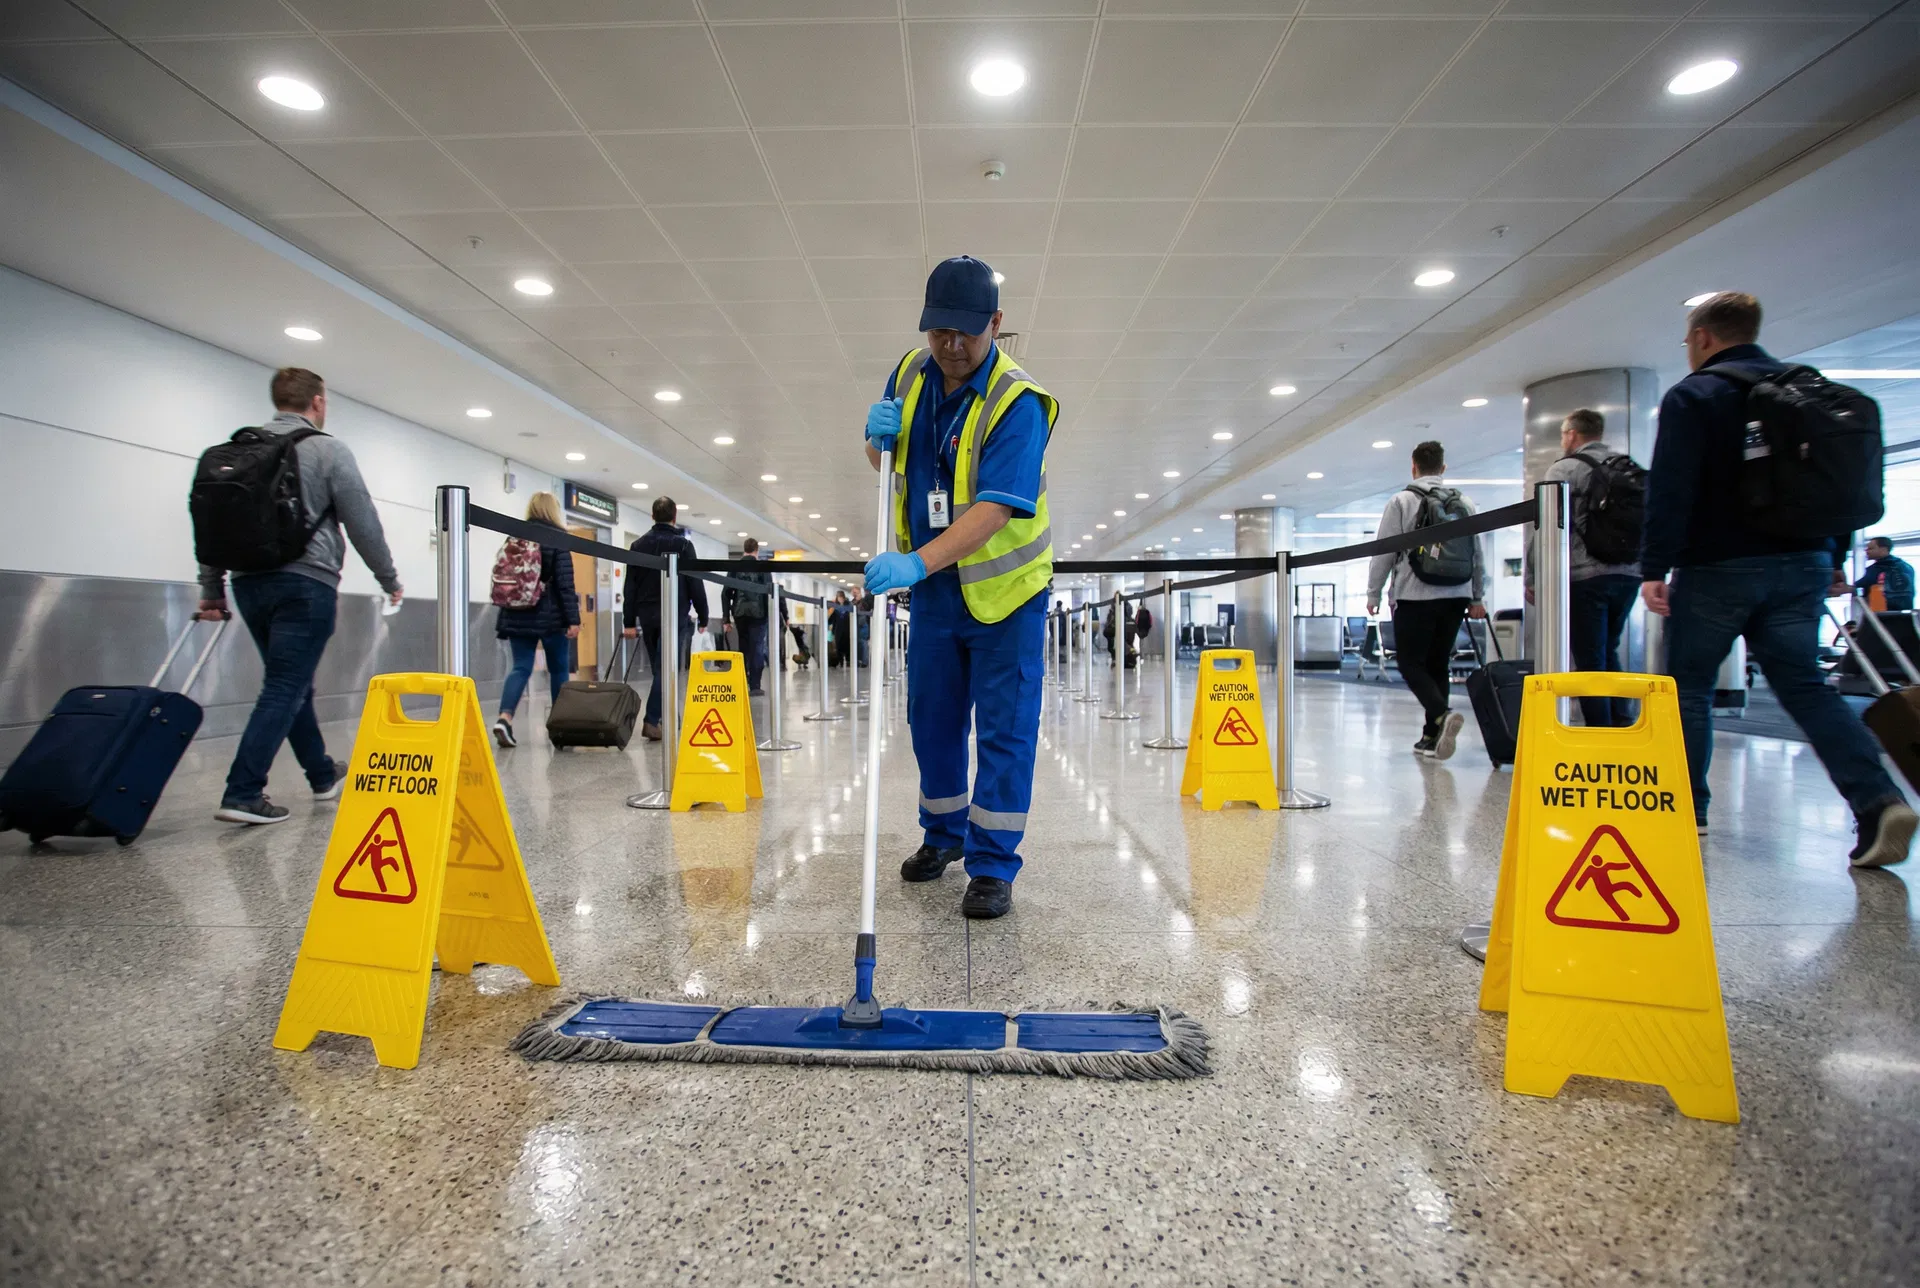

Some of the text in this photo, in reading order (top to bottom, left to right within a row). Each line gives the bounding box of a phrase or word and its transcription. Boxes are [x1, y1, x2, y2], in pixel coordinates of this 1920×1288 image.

[697, 685, 732, 693] CAUTION
[1213, 684, 1248, 692] CAUTION
[692, 693, 737, 703] WET FLOOR
[1209, 693, 1254, 701] WET FLOOR
[368, 752, 433, 772] CAUTION
[1554, 762, 1658, 785] CAUTION
[355, 774, 437, 796] WET FLOOR
[1541, 786, 1675, 812] WET FLOOR
